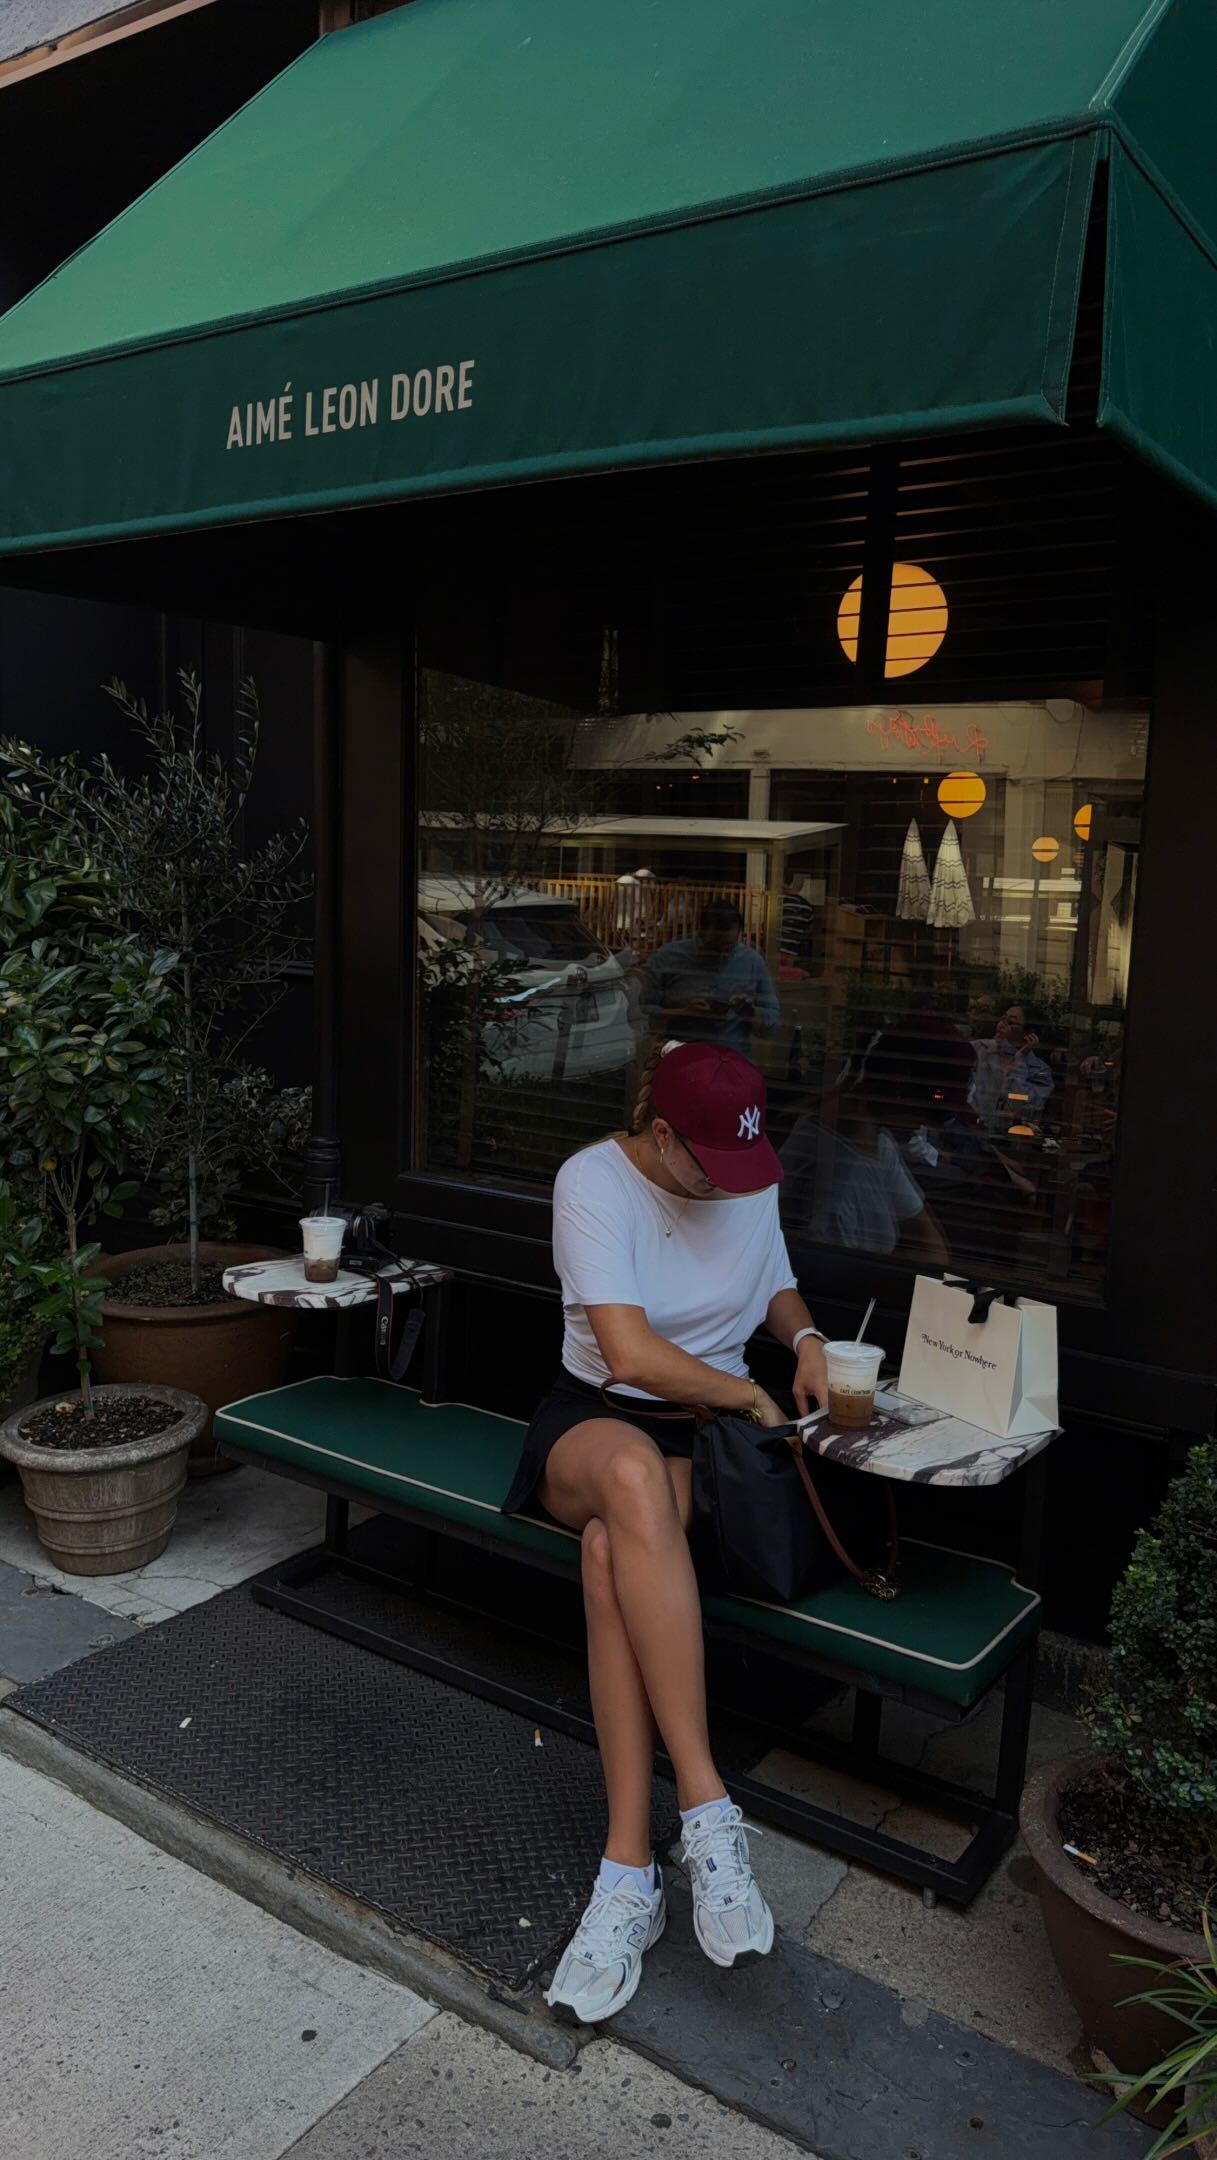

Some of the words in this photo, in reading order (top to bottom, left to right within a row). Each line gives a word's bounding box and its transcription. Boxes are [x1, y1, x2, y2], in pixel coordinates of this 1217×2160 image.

[226, 381, 293, 449] AIMÉ
[305, 378, 378, 436] LEON
[390, 359, 475, 421] DORE
[737, 1104, 760, 1140] NY
[921, 1333, 938, 1347] New
[939, 1340, 957, 1357] York
[964, 1349, 998, 1370] Nowhere
